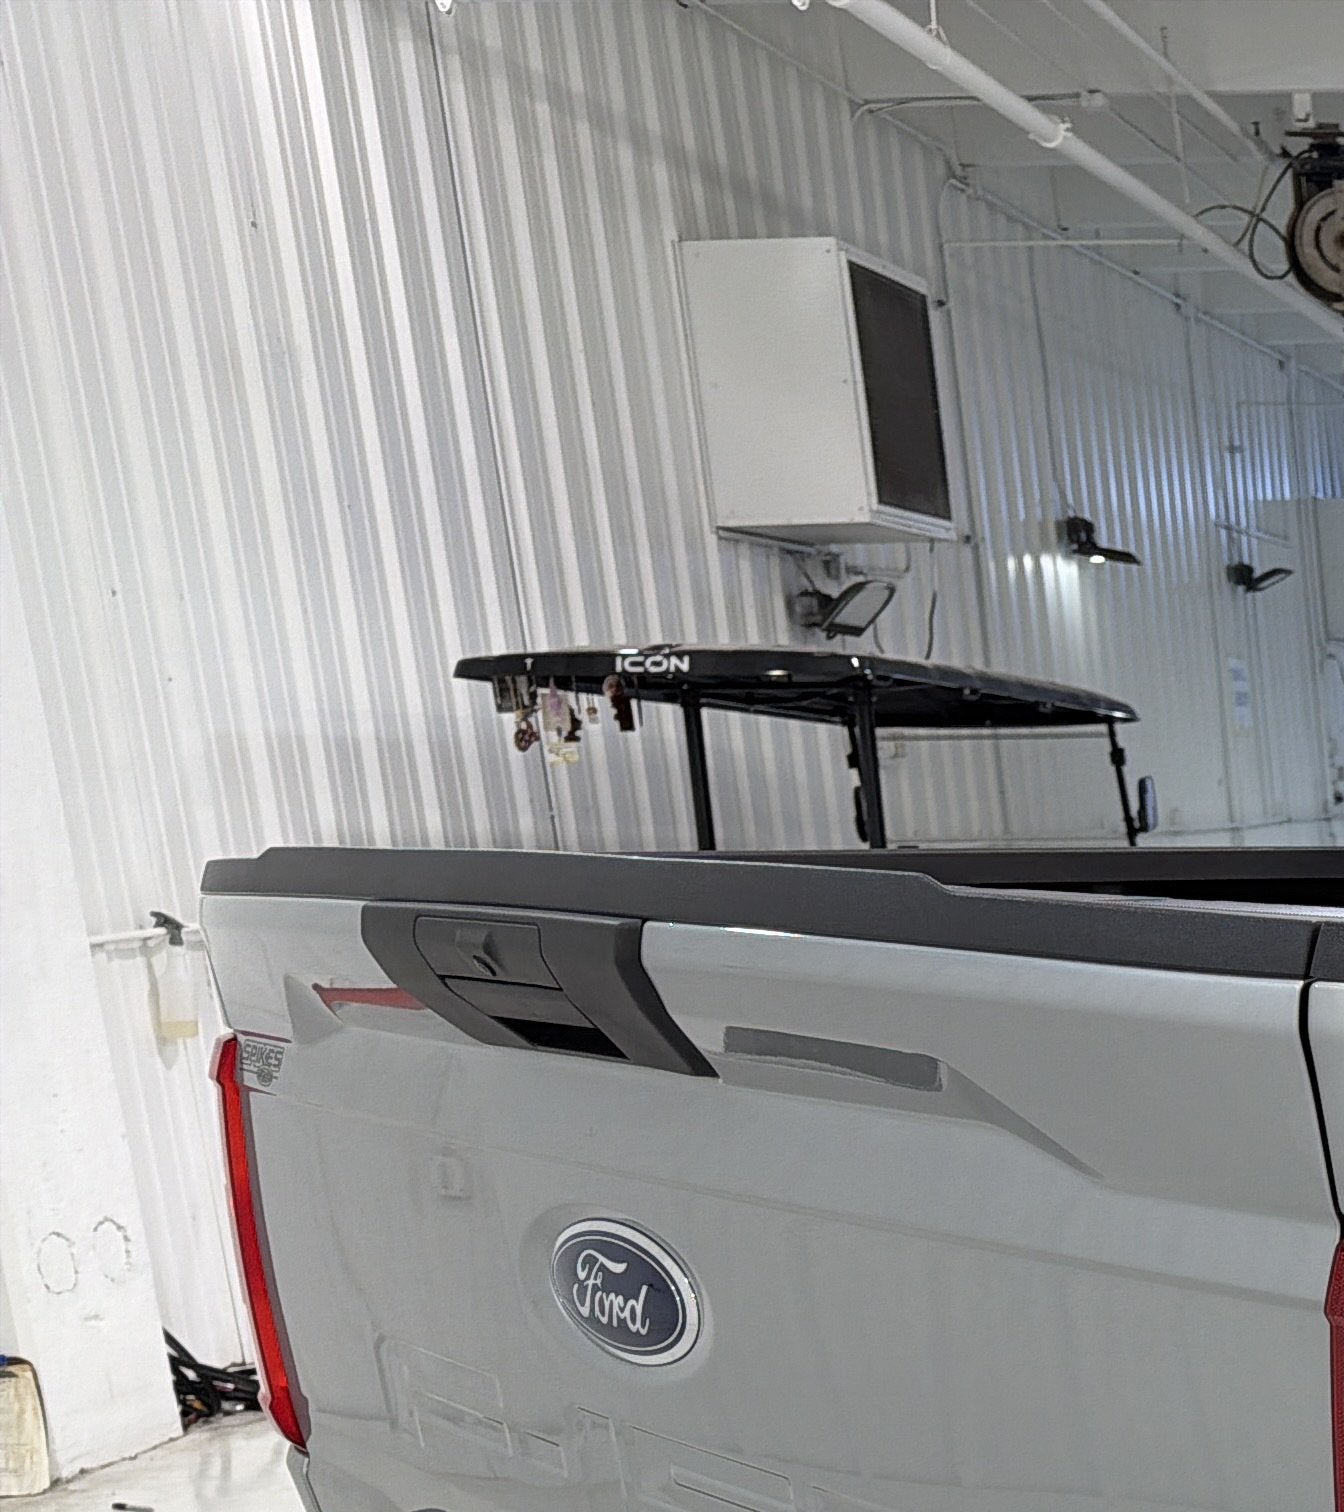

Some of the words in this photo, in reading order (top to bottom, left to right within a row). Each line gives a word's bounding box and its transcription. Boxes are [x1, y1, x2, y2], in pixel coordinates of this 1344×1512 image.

[614, 654, 690, 673] ICON
[241, 1041, 284, 1069] SPIKES
[572, 1248, 650, 1336] Ford
